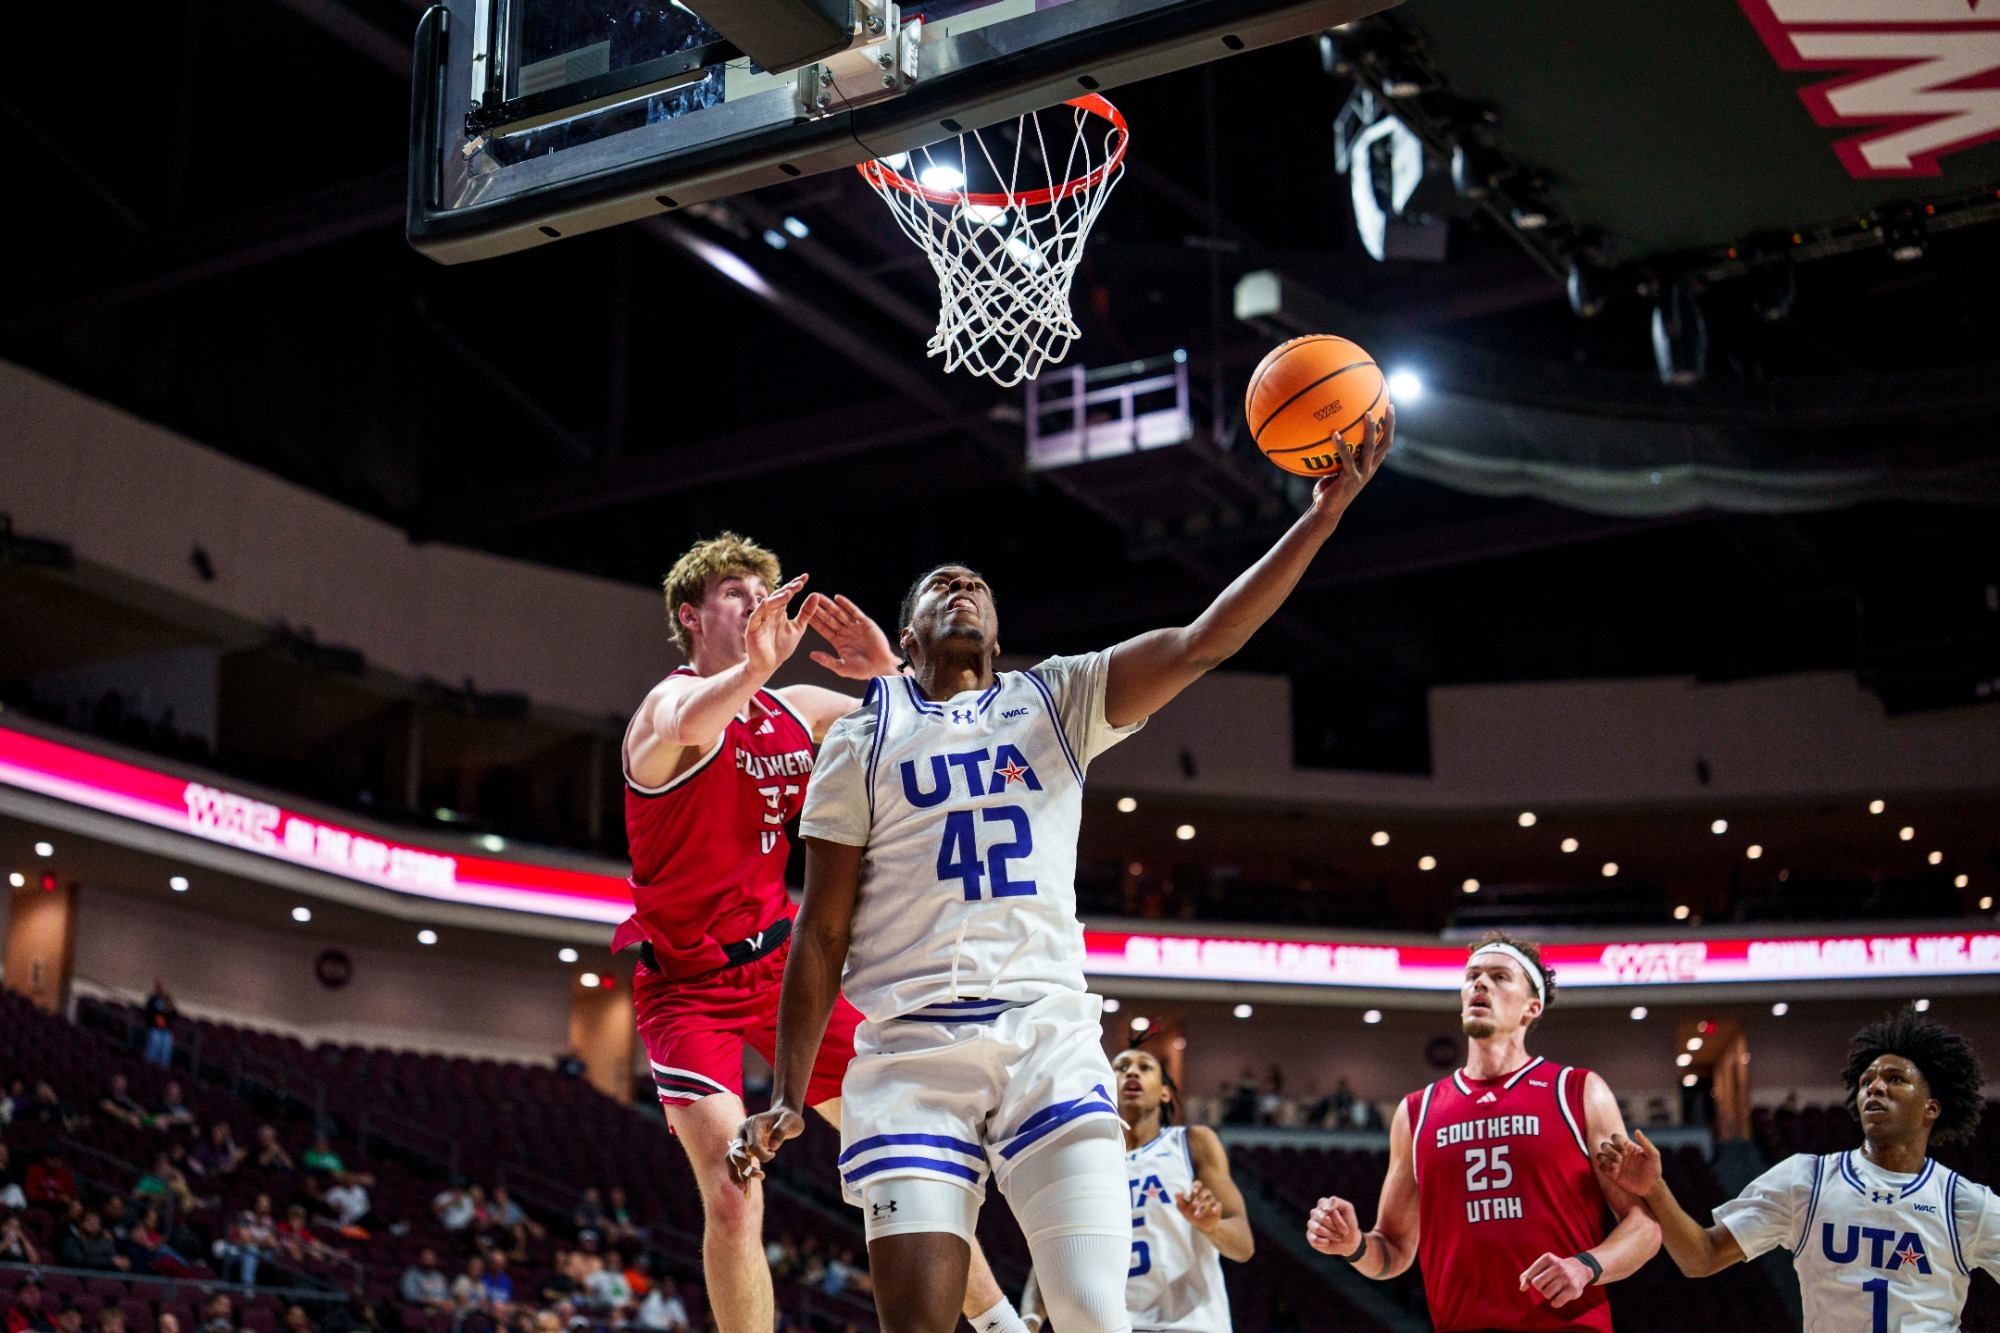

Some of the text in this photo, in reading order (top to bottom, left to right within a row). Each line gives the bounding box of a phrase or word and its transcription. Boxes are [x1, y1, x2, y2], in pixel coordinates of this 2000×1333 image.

[1313, 400, 1342, 421] WAC
[1001, 707, 1029, 719] WAC
[900, 743, 1043, 809] UTA
[936, 804, 1038, 902] 42
[1602, 943, 1705, 983] WAC
[1528, 1079, 1549, 1088] WAC
[1436, 1115, 1540, 1148] SOUTHERN
[1464, 1144, 1513, 1192] 25
[1466, 1197, 1523, 1223] UTAH
[1913, 1202, 1937, 1214] WAC
[1822, 1222, 1932, 1275] UTA
[1862, 1277, 1889, 1333] 1
